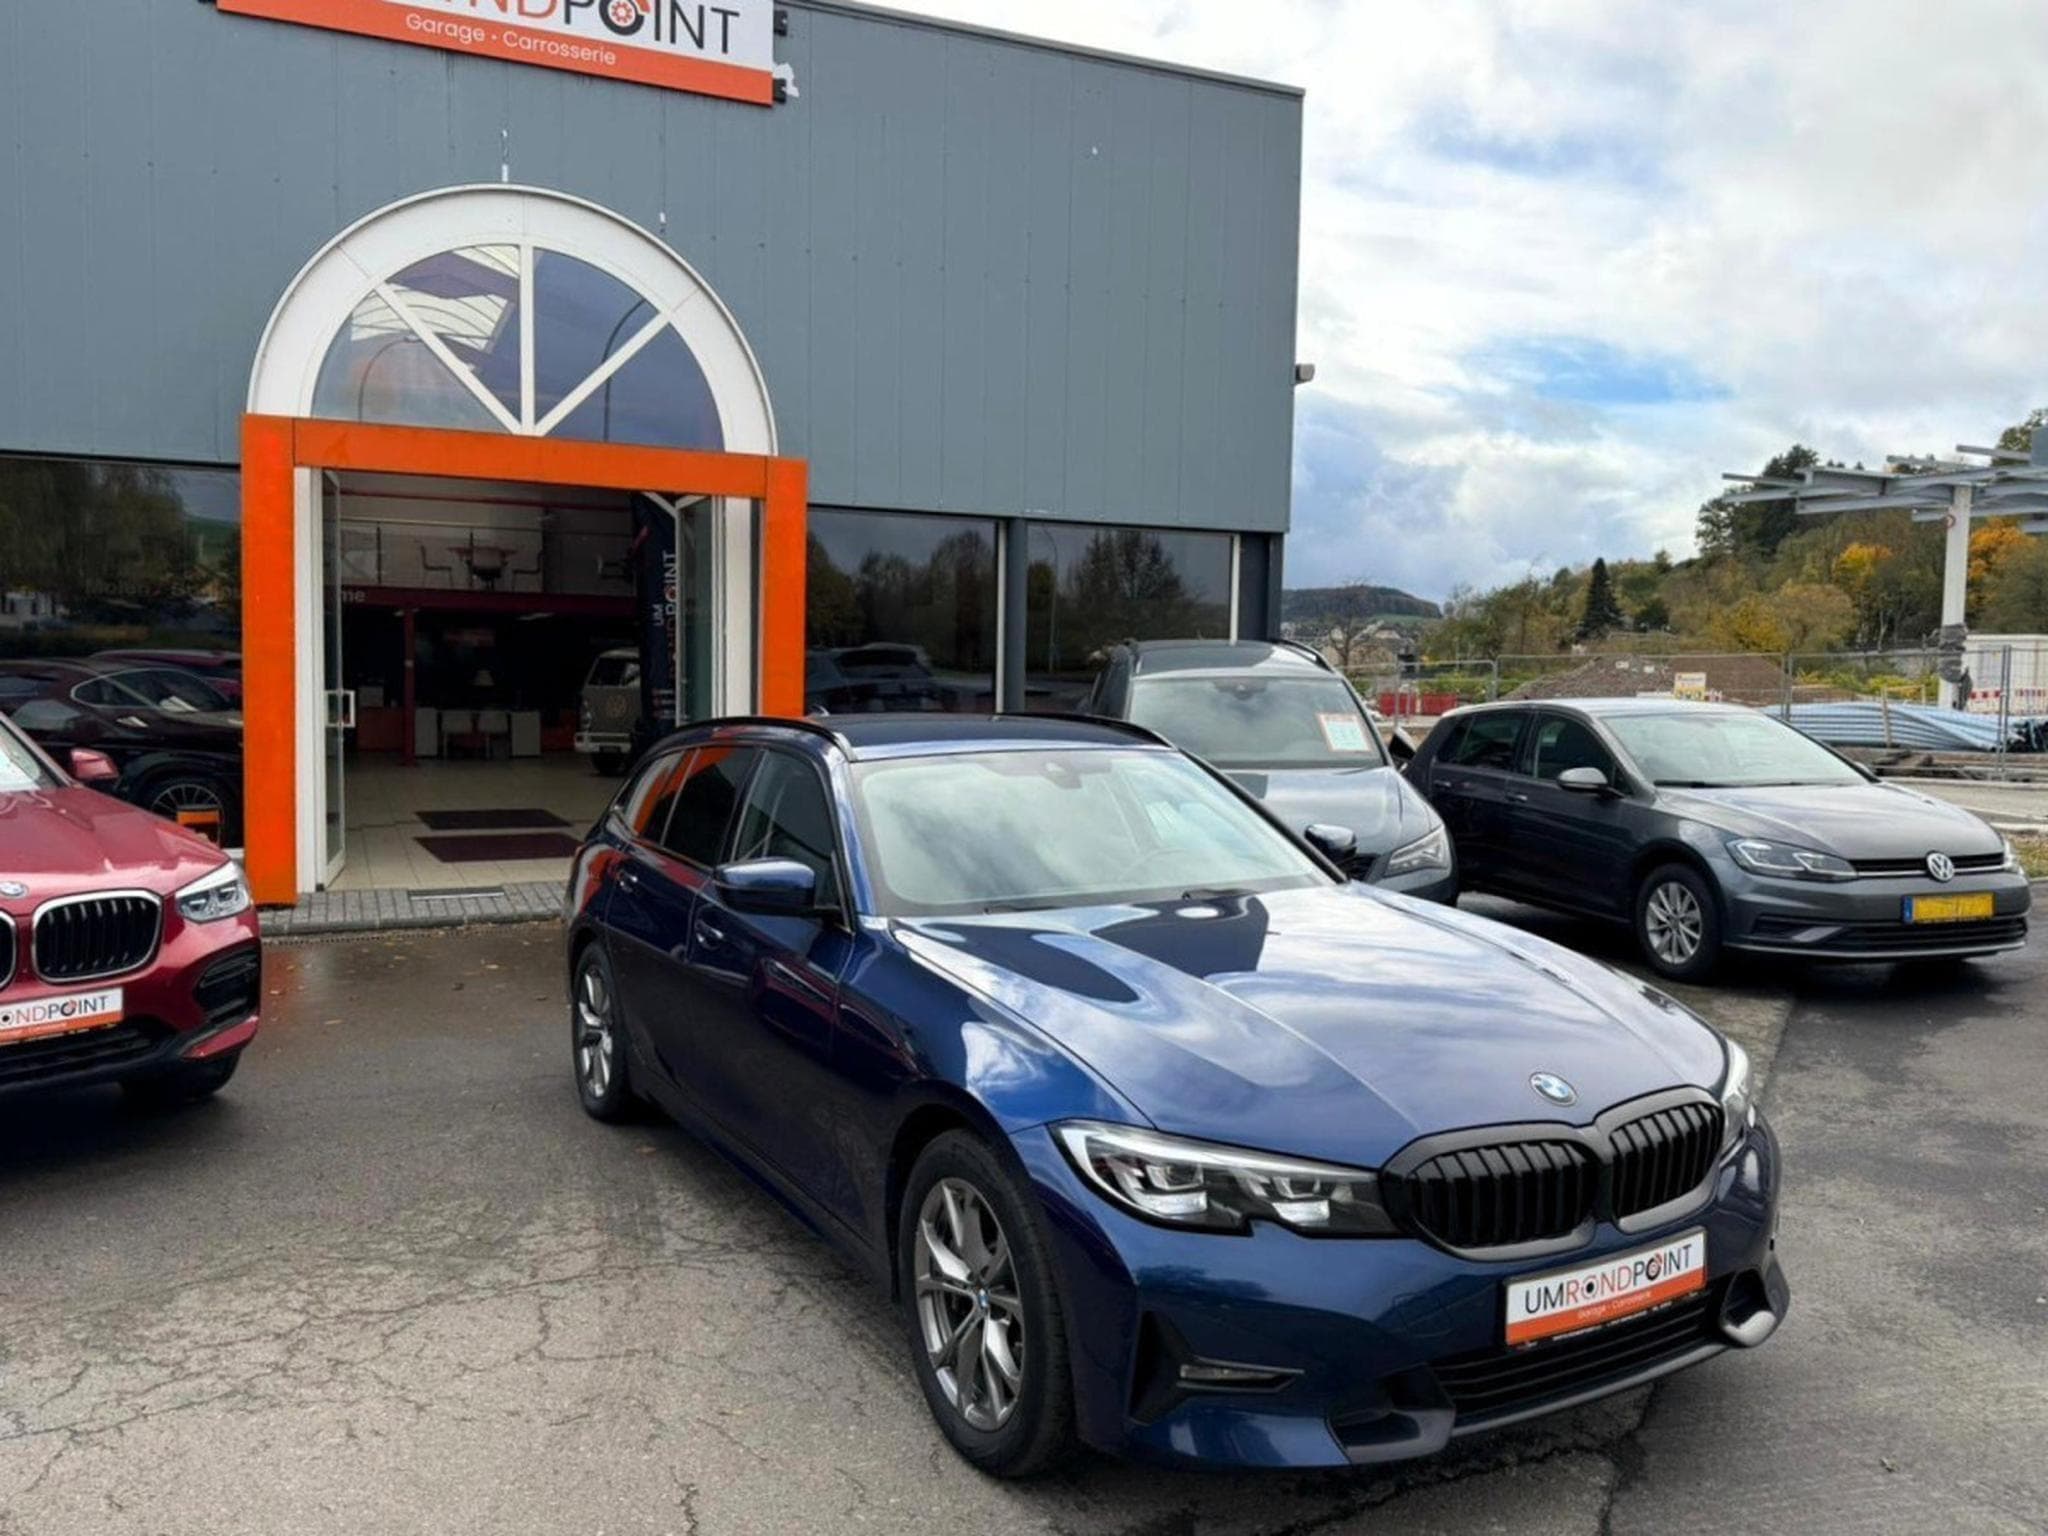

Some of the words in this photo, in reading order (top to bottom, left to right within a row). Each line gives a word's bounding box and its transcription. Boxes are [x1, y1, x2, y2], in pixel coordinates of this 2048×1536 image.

[405, 13, 485, 44] Garage
[502, 31, 616, 66] Carrosserie
[1524, 1244, 1692, 1314] UMRONDPOINT
